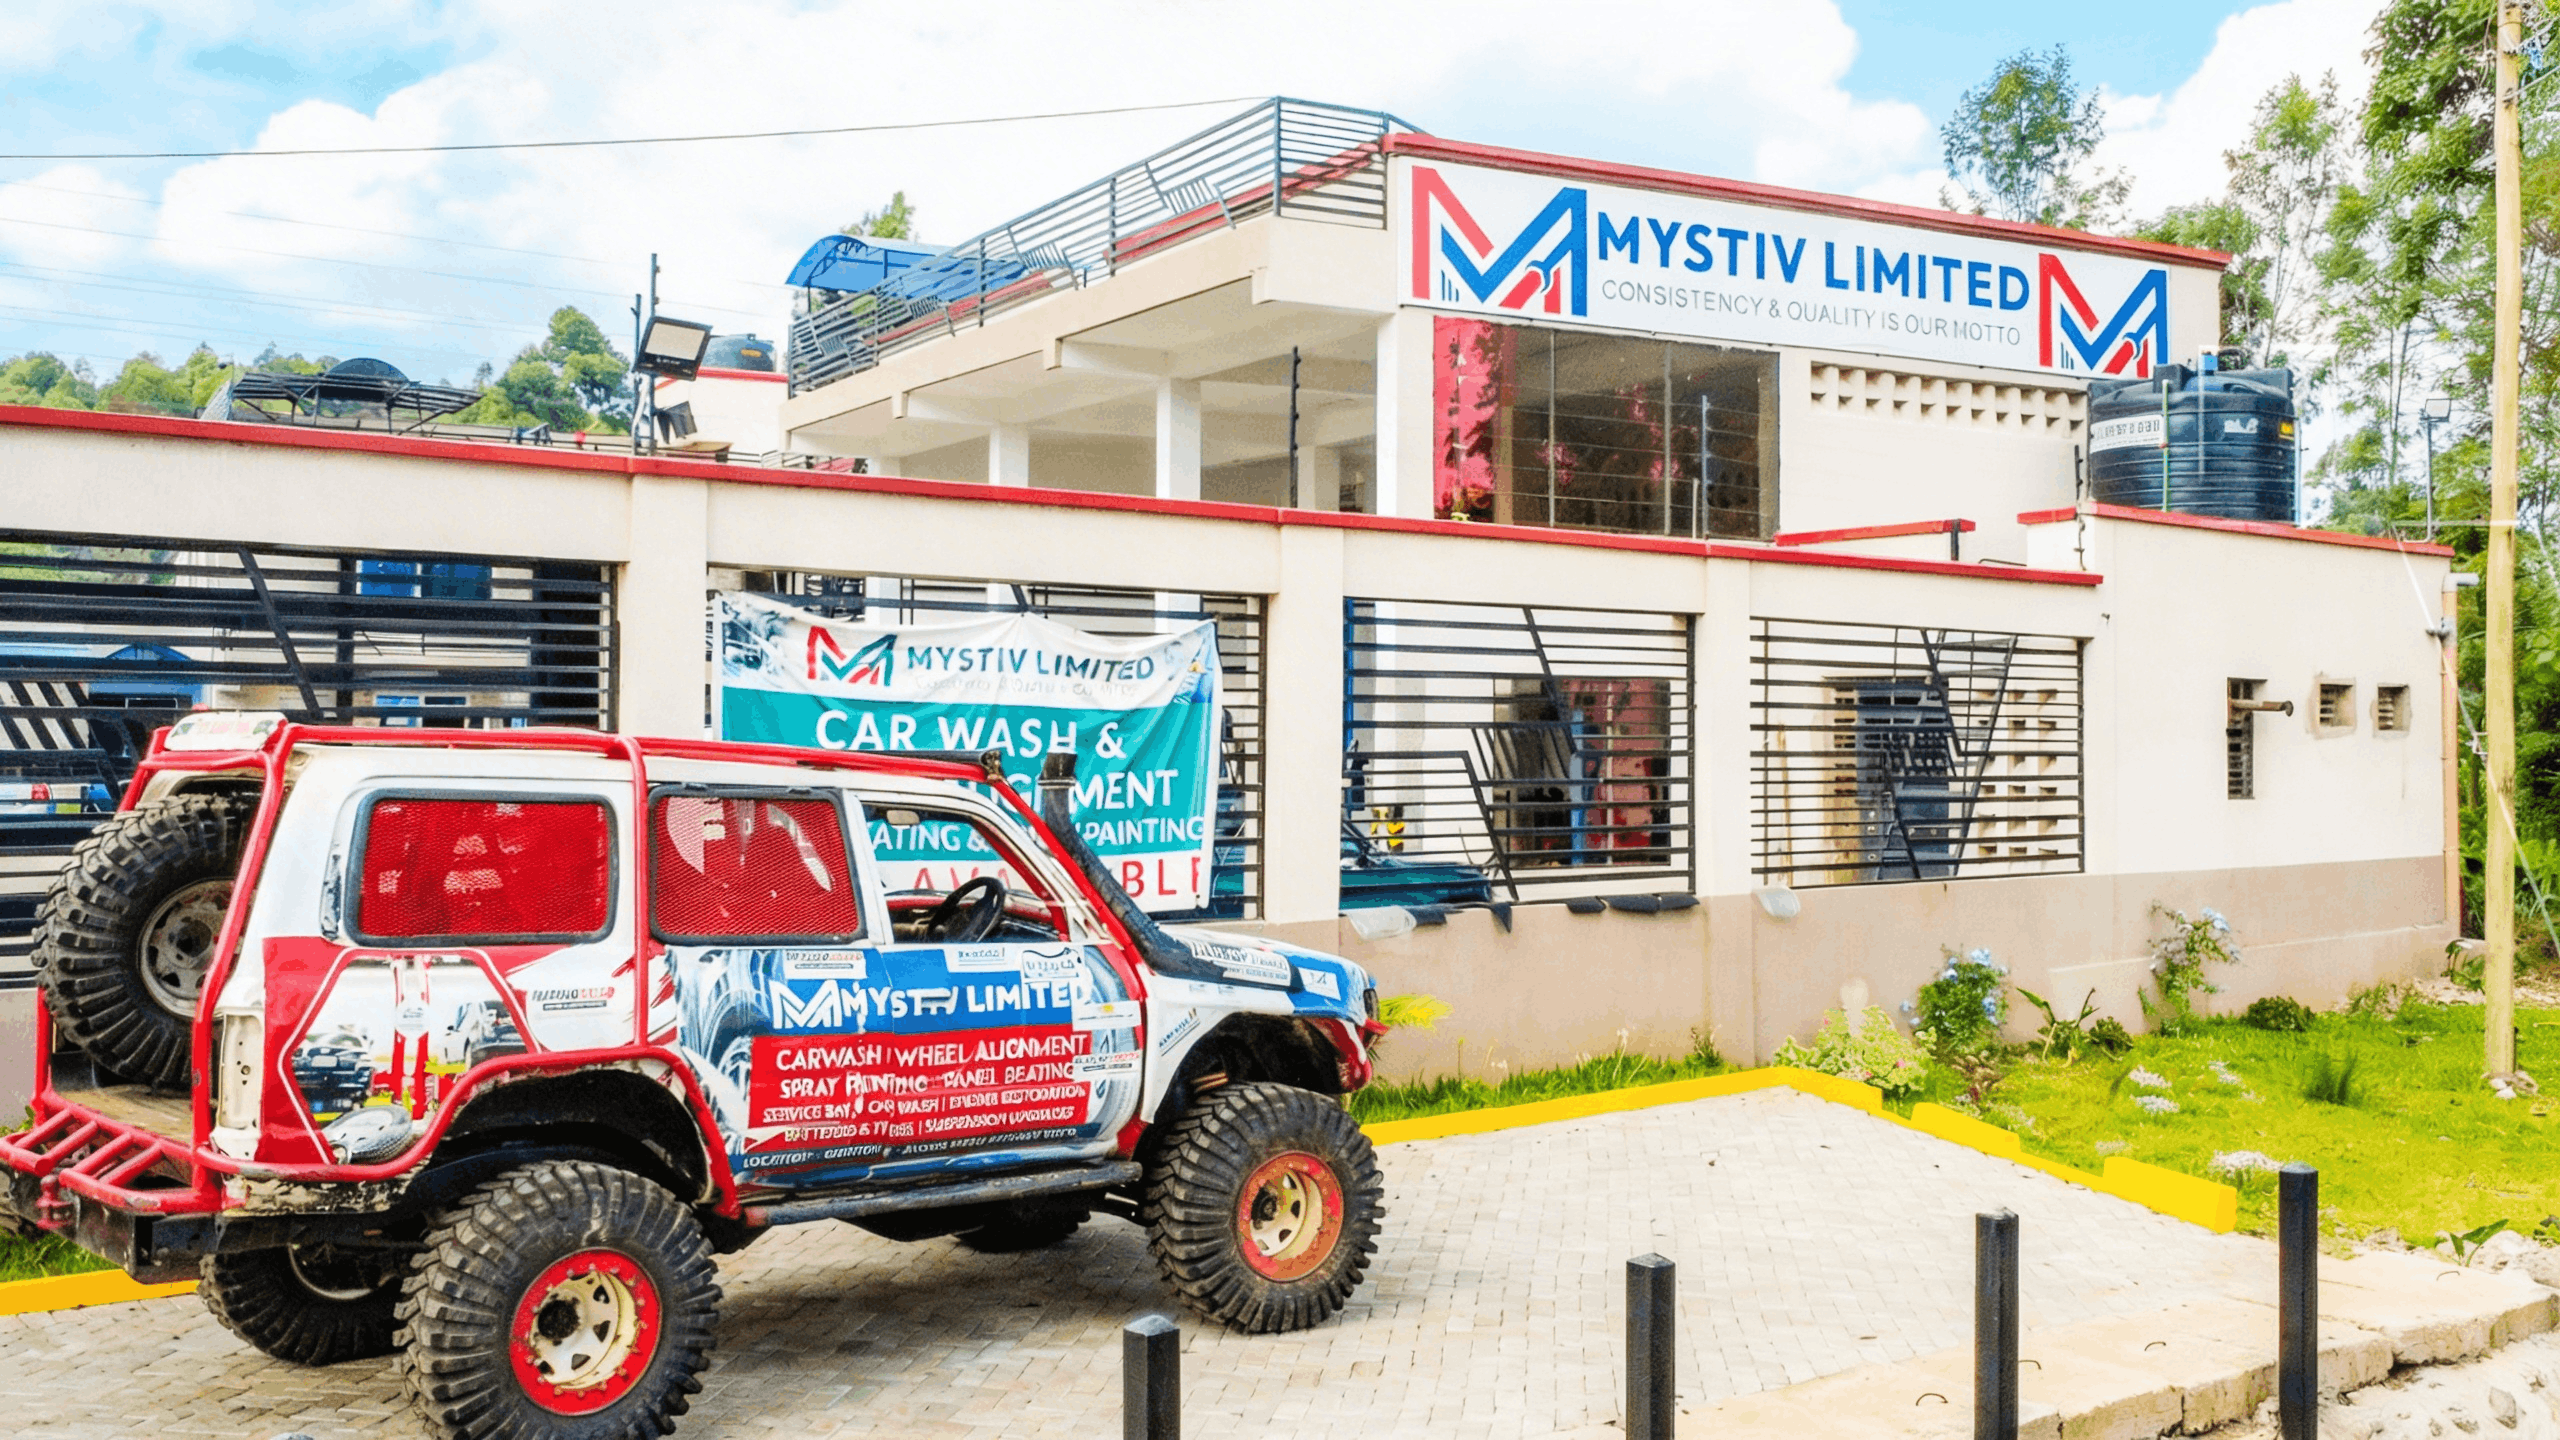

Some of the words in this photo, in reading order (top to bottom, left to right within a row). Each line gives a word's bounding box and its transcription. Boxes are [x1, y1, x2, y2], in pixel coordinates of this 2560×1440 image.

[1598, 211, 1806, 283] MYSTIV
[1825, 241, 2030, 311] LIMITED
[1601, 279, 1764, 316] CONSISTENCY
[1769, 299, 1782, 318] &
[1787, 301, 1876, 329] QUALITY
[1882, 311, 1899, 331] IS
[1905, 314, 1948, 338] OUR
[1953, 320, 2021, 346] MOTTO
[907, 645, 1028, 673] MYSTIV
[1037, 651, 1155, 682] LIMITED
[815, 710, 917, 750] CAR
[937, 716, 1077, 758] WASH
[1095, 721, 1127, 759] &
[776, 1044, 882, 1070] CARWASH
[895, 1043, 967, 1067] WHEEL
[780, 1076, 842, 1099] SPRAY
[1004, 1062, 1074, 1085] BEATING
